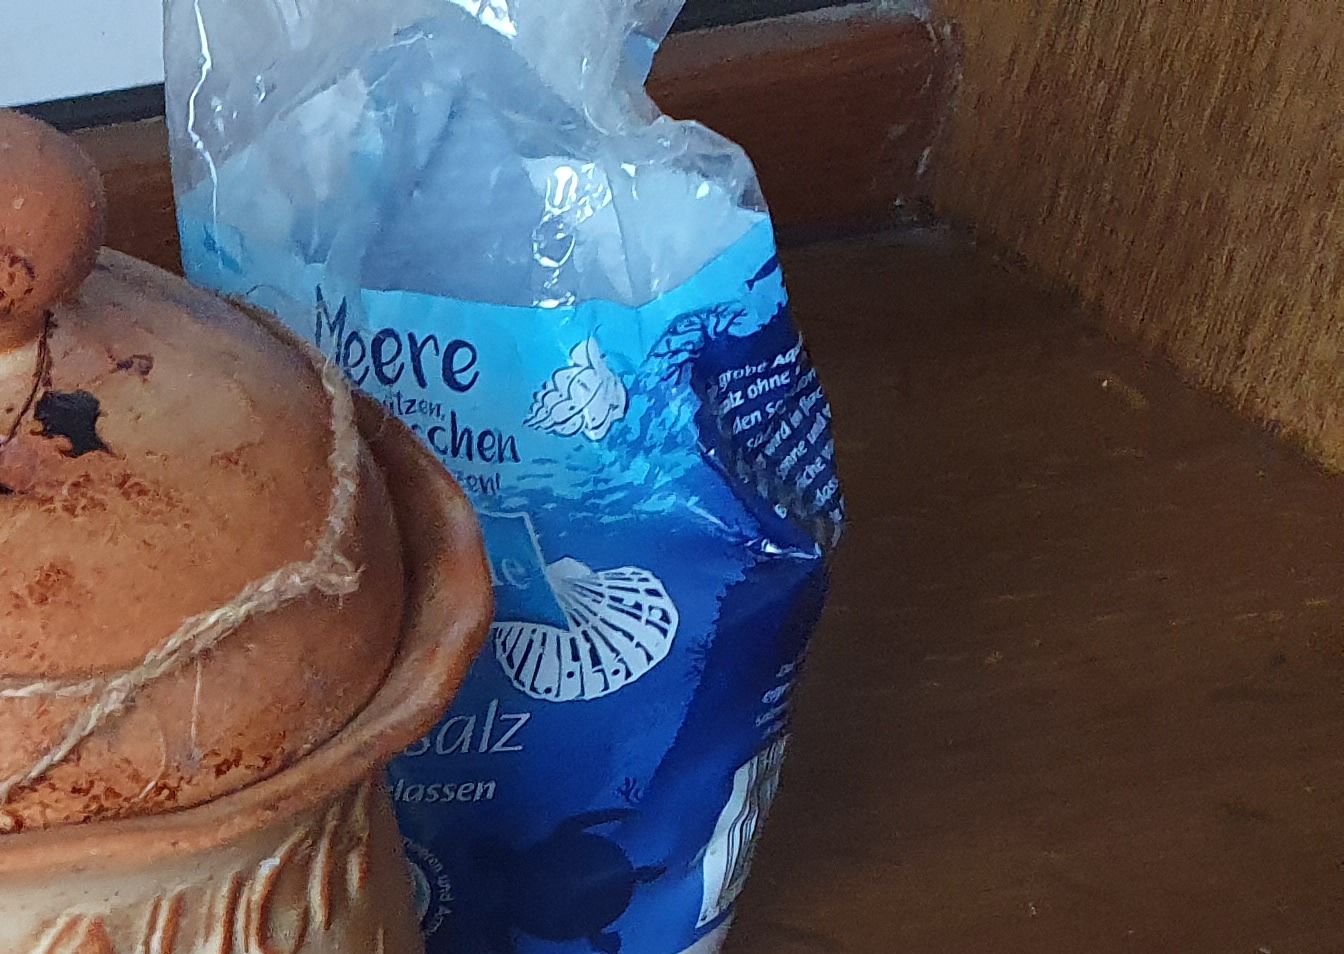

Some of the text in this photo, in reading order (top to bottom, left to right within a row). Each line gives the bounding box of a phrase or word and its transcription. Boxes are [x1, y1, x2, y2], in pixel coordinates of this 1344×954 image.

[315, 283, 480, 393] Meere
[718, 390, 745, 415] alz
[747, 370, 791, 399] ohne
[412, 410, 521, 464] chen
[390, 776, 497, 802] lassen
